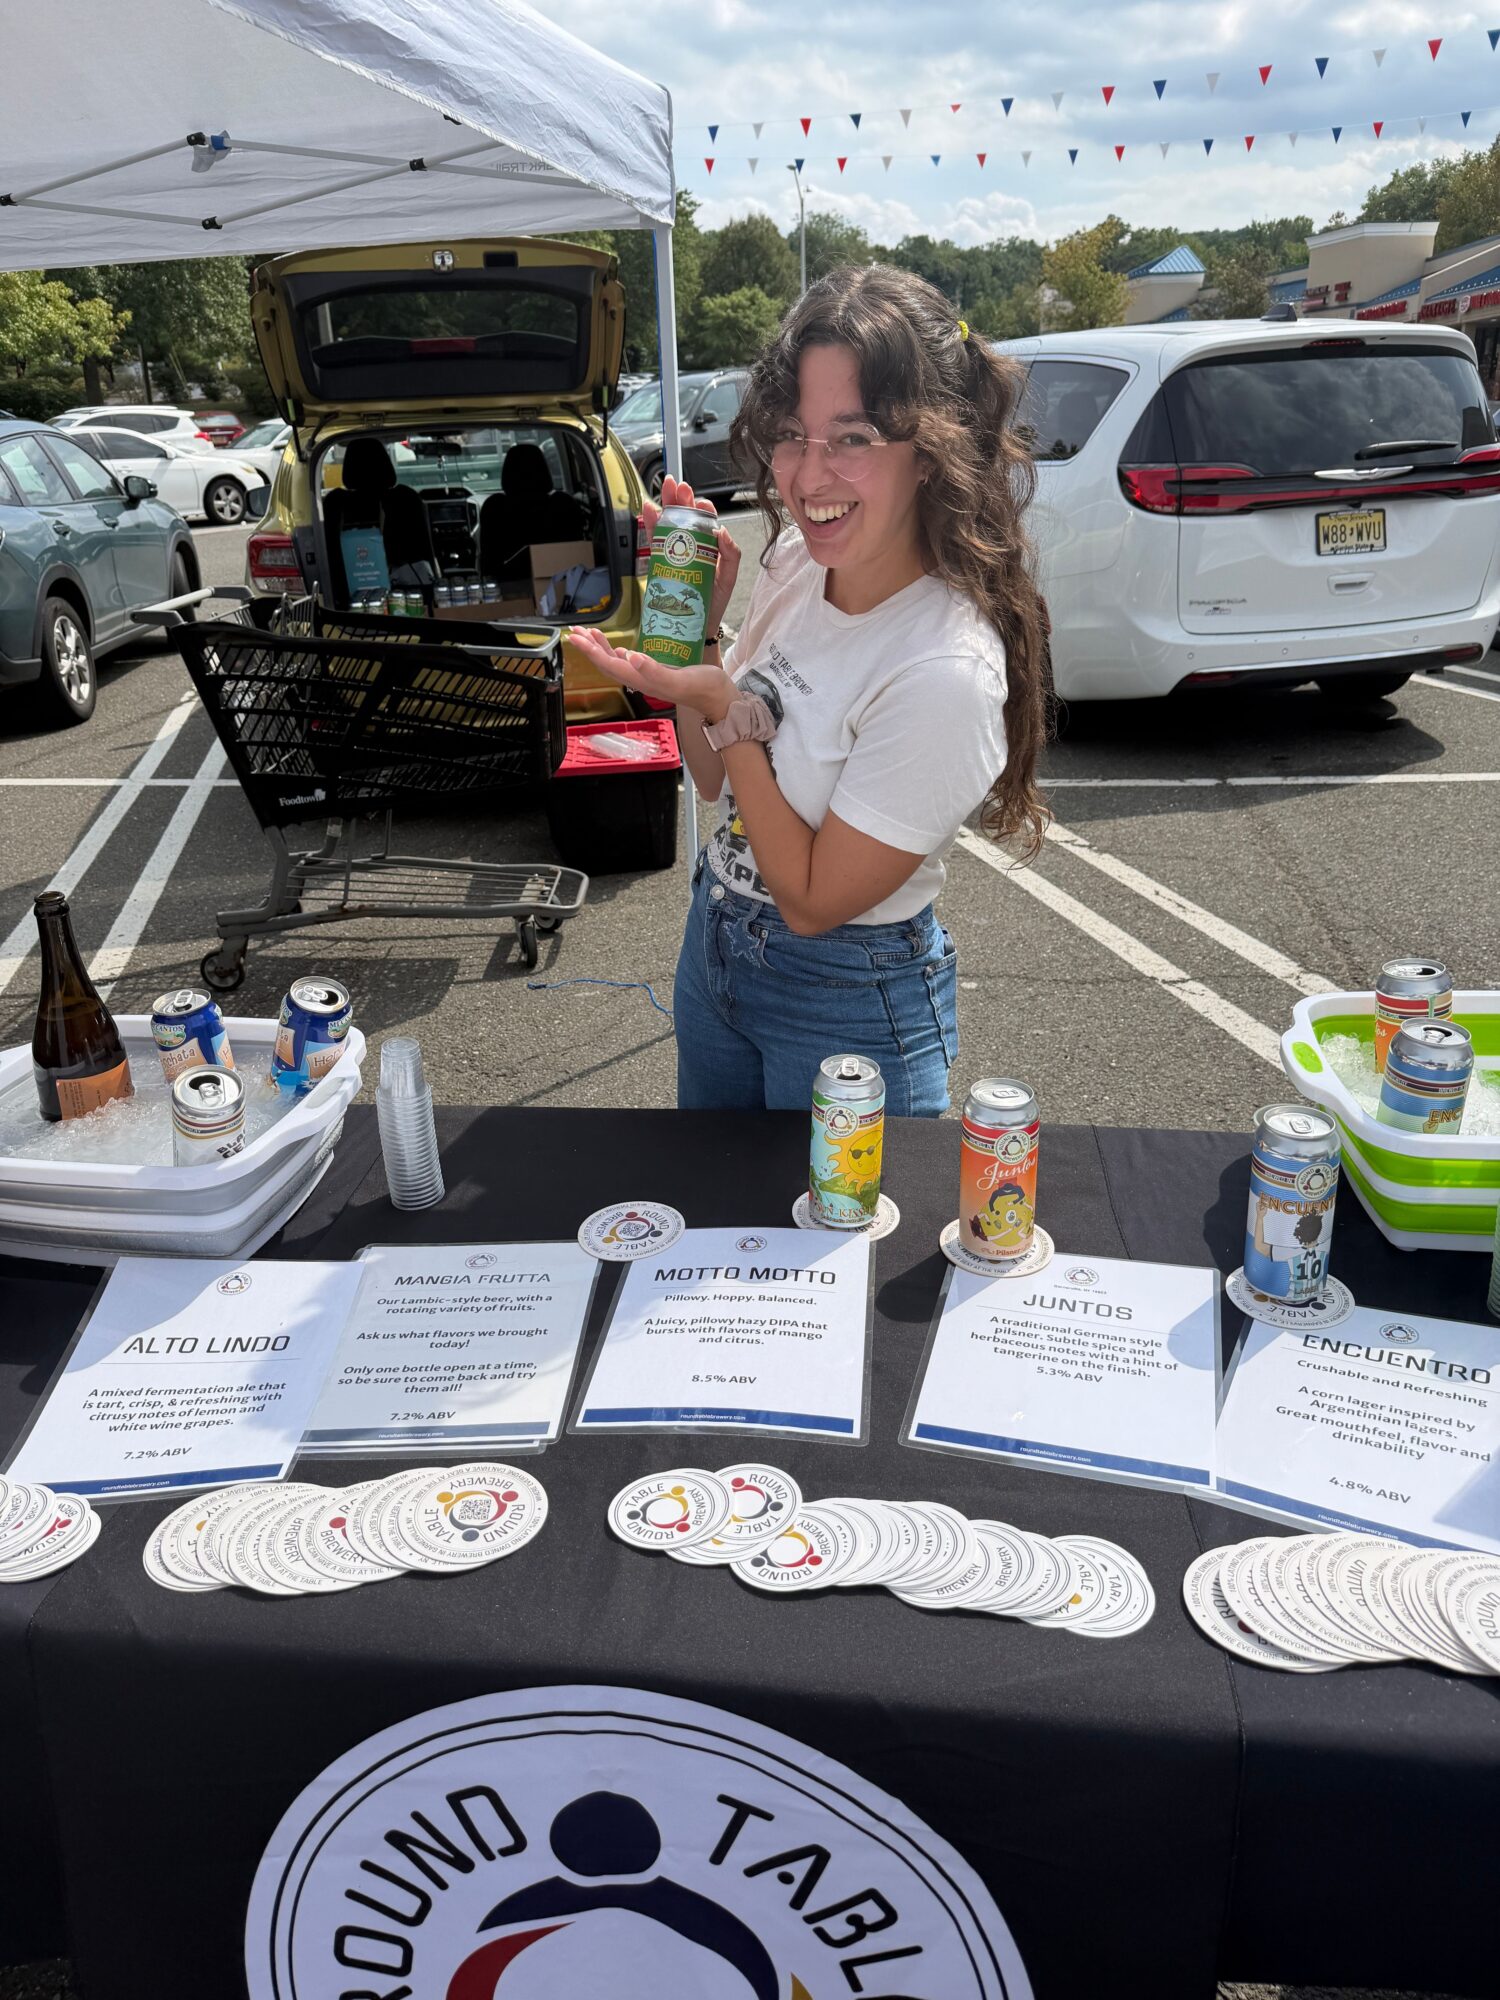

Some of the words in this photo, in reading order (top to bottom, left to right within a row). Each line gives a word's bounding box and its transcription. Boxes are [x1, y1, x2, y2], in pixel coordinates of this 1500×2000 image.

[1322, 523, 1347, 545] W88
[1356, 520, 1381, 542] WVU
[279, 795, 320, 806] Foodtown
[976, 1154, 1036, 1192] Juntos
[594, 1211, 625, 1238] BREWERY
[641, 1210, 669, 1231] ROUND
[613, 1239, 657, 1251] TABLE
[996, 1248, 1021, 1257] Pilsner
[393, 1274, 472, 1286] MANGIA
[477, 1273, 551, 1284] FRUTTA
[653, 1266, 741, 1282] MOTTO
[748, 1266, 837, 1285] MOTTO
[1295, 1259, 1323, 1281] 10
[376, 1296, 402, 1306] Our
[402, 1296, 482, 1304] Lambic-style
[482, 1295, 514, 1304] beer,
[515, 1293, 544, 1303] with
[385, 1305, 438, 1315] rotating
[439, 1304, 484, 1314] variety
[483, 1303, 499, 1312] of
[499, 1303, 536, 1312] fruits.
[664, 1293, 711, 1303] Pillowy.
[712, 1293, 755, 1303] Hoppy.
[757, 1294, 817, 1306] Balanced.
[1022, 1293, 1133, 1321] JUNTOS
[643, 1317, 654, 1326] A
[689, 1316, 736, 1327] pillowy
[737, 1316, 767, 1327] hazy
[768, 1318, 799, 1328] DIPA
[801, 1320, 828, 1331] that
[645, 1327, 686, 1335] bursts
[687, 1325, 716, 1334] with
[718, 1325, 761, 1335] flavors
[763, 1327, 778, 1336] of
[778, 1330, 823, 1341] mango
[989, 1315, 999, 1324] A
[1001, 1317, 1071, 1335] traditional
[1073, 1328, 1127, 1343] German
[1129, 1337, 1163, 1348] style
[356, 1331, 381, 1341] Ask
[399, 1330, 431, 1339] what
[432, 1329, 476, 1339] flavors
[497, 1327, 549, 1338] brought
[429, 1338, 471, 1350] today!
[698, 1335, 723, 1344] and
[724, 1335, 765, 1345] citrus.
[993, 1326, 1044, 1341] pilsner.
[1046, 1333, 1090, 1347] Subtle
[1091, 1342, 1127, 1353] spice
[1128, 1347, 1155, 1358] and
[123, 1336, 199, 1355] ALTO
[205, 1335, 291, 1354] LINDO
[970, 1331, 1046, 1351] herbaceous
[1048, 1345, 1087, 1357] notes
[1088, 1351, 1119, 1363] with
[1133, 1356, 1162, 1369] hint
[1163, 1363, 1178, 1371] of
[343, 1365, 375, 1377] Only
[375, 1366, 401, 1374] one
[401, 1363, 442, 1373] bottle
[443, 1364, 476, 1374] open
[477, 1363, 493, 1371] at
[503, 1361, 537, 1370] time,
[993, 1346, 1059, 1363] tangerine
[1061, 1358, 1079, 1367] on
[1081, 1359, 1105, 1371] the
[1107, 1363, 1151, 1378] finish.
[1301, 1333, 1491, 1385] ENCUENTRO
[337, 1377, 353, 1385] so
[354, 1375, 372, 1385] be
[403, 1375, 418, 1383] to
[419, 1375, 456, 1383] come
[456, 1372, 489, 1382] back
[489, 1370, 516, 1381] and
[516, 1371, 537, 1381] try
[691, 1374, 727, 1383] 8.5%
[728, 1375, 758, 1385] ABV
[1036, 1365, 1072, 1378] 5.3%
[1073, 1372, 1103, 1383] ABV
[1297, 1359, 1370, 1381] Crushable
[1371, 1376, 1401, 1388] and
[1403, 1382, 1488, 1408] Refreshing
[87, 1388, 99, 1398] A
[100, 1387, 145, 1397] mixed
[145, 1385, 233, 1396] fermentation
[235, 1383, 257, 1393] ale
[258, 1381, 287, 1391] that
[404, 1384, 440, 1394] them
[441, 1382, 463, 1393] all!
[81, 1399, 95, 1409] is
[95, 1400, 125, 1411] tart,
[128, 1398, 165, 1411] crisp,
[167, 1397, 178, 1407] &
[179, 1394, 251, 1407] refreshing
[252, 1391, 283, 1402] with
[1297, 1385, 1309, 1395] A
[1311, 1389, 1345, 1402] corn
[1347, 1395, 1387, 1411] lager
[1388, 1404, 1453, 1427] inspired
[1456, 1419, 1476, 1433] by
[89, 1411, 138, 1423] citrusy
[137, 1410, 177, 1420] notes
[177, 1407, 195, 1418] of
[193, 1407, 237, 1417] lemon
[238, 1403, 266, 1414] and
[389, 1412, 425, 1421] 7.2%
[425, 1411, 457, 1420] ABV
[1309, 1399, 1402, 1426] Argentinian
[1404, 1419, 1457, 1439] lagers.
[108, 1422, 148, 1433] white
[149, 1420, 183, 1431] wine
[182, 1418, 234, 1431] grapes.
[1275, 1405, 1318, 1422] Great
[1319, 1417, 1406, 1445] mouthfeel,
[1409, 1435, 1457, 1454] flavor
[1459, 1449, 1491, 1463] and
[123, 1449, 159, 1460] 7.2%
[159, 1446, 193, 1457] ABV
[1332, 1431, 1424, 1460] drinkability
[449, 1477, 514, 1490] BREWERY
[749, 1473, 788, 1501] ROUND
[1328, 1476, 1373, 1495] 4.8%
[1375, 1488, 1411, 1504] ABV
[625, 1482, 665, 1508] TABLE
[687, 1486, 707, 1527] BREWERY
[424, 1506, 455, 1544] TABLE
[482, 1503, 526, 1543] ROUND
[627, 1521, 675, 1541] ROUND
[733, 1515, 781, 1535] TABLE
[757, 1567, 813, 1581] ROUND
[796, 1518, 832, 1556] BREWERY
[995, 1545, 1014, 1588] BREWERY
[1210, 1624, 1236, 1646] WHERE
[1236, 1641, 1279, 1661] EVERYONE
[708, 1793, 932, 2000] TABL
